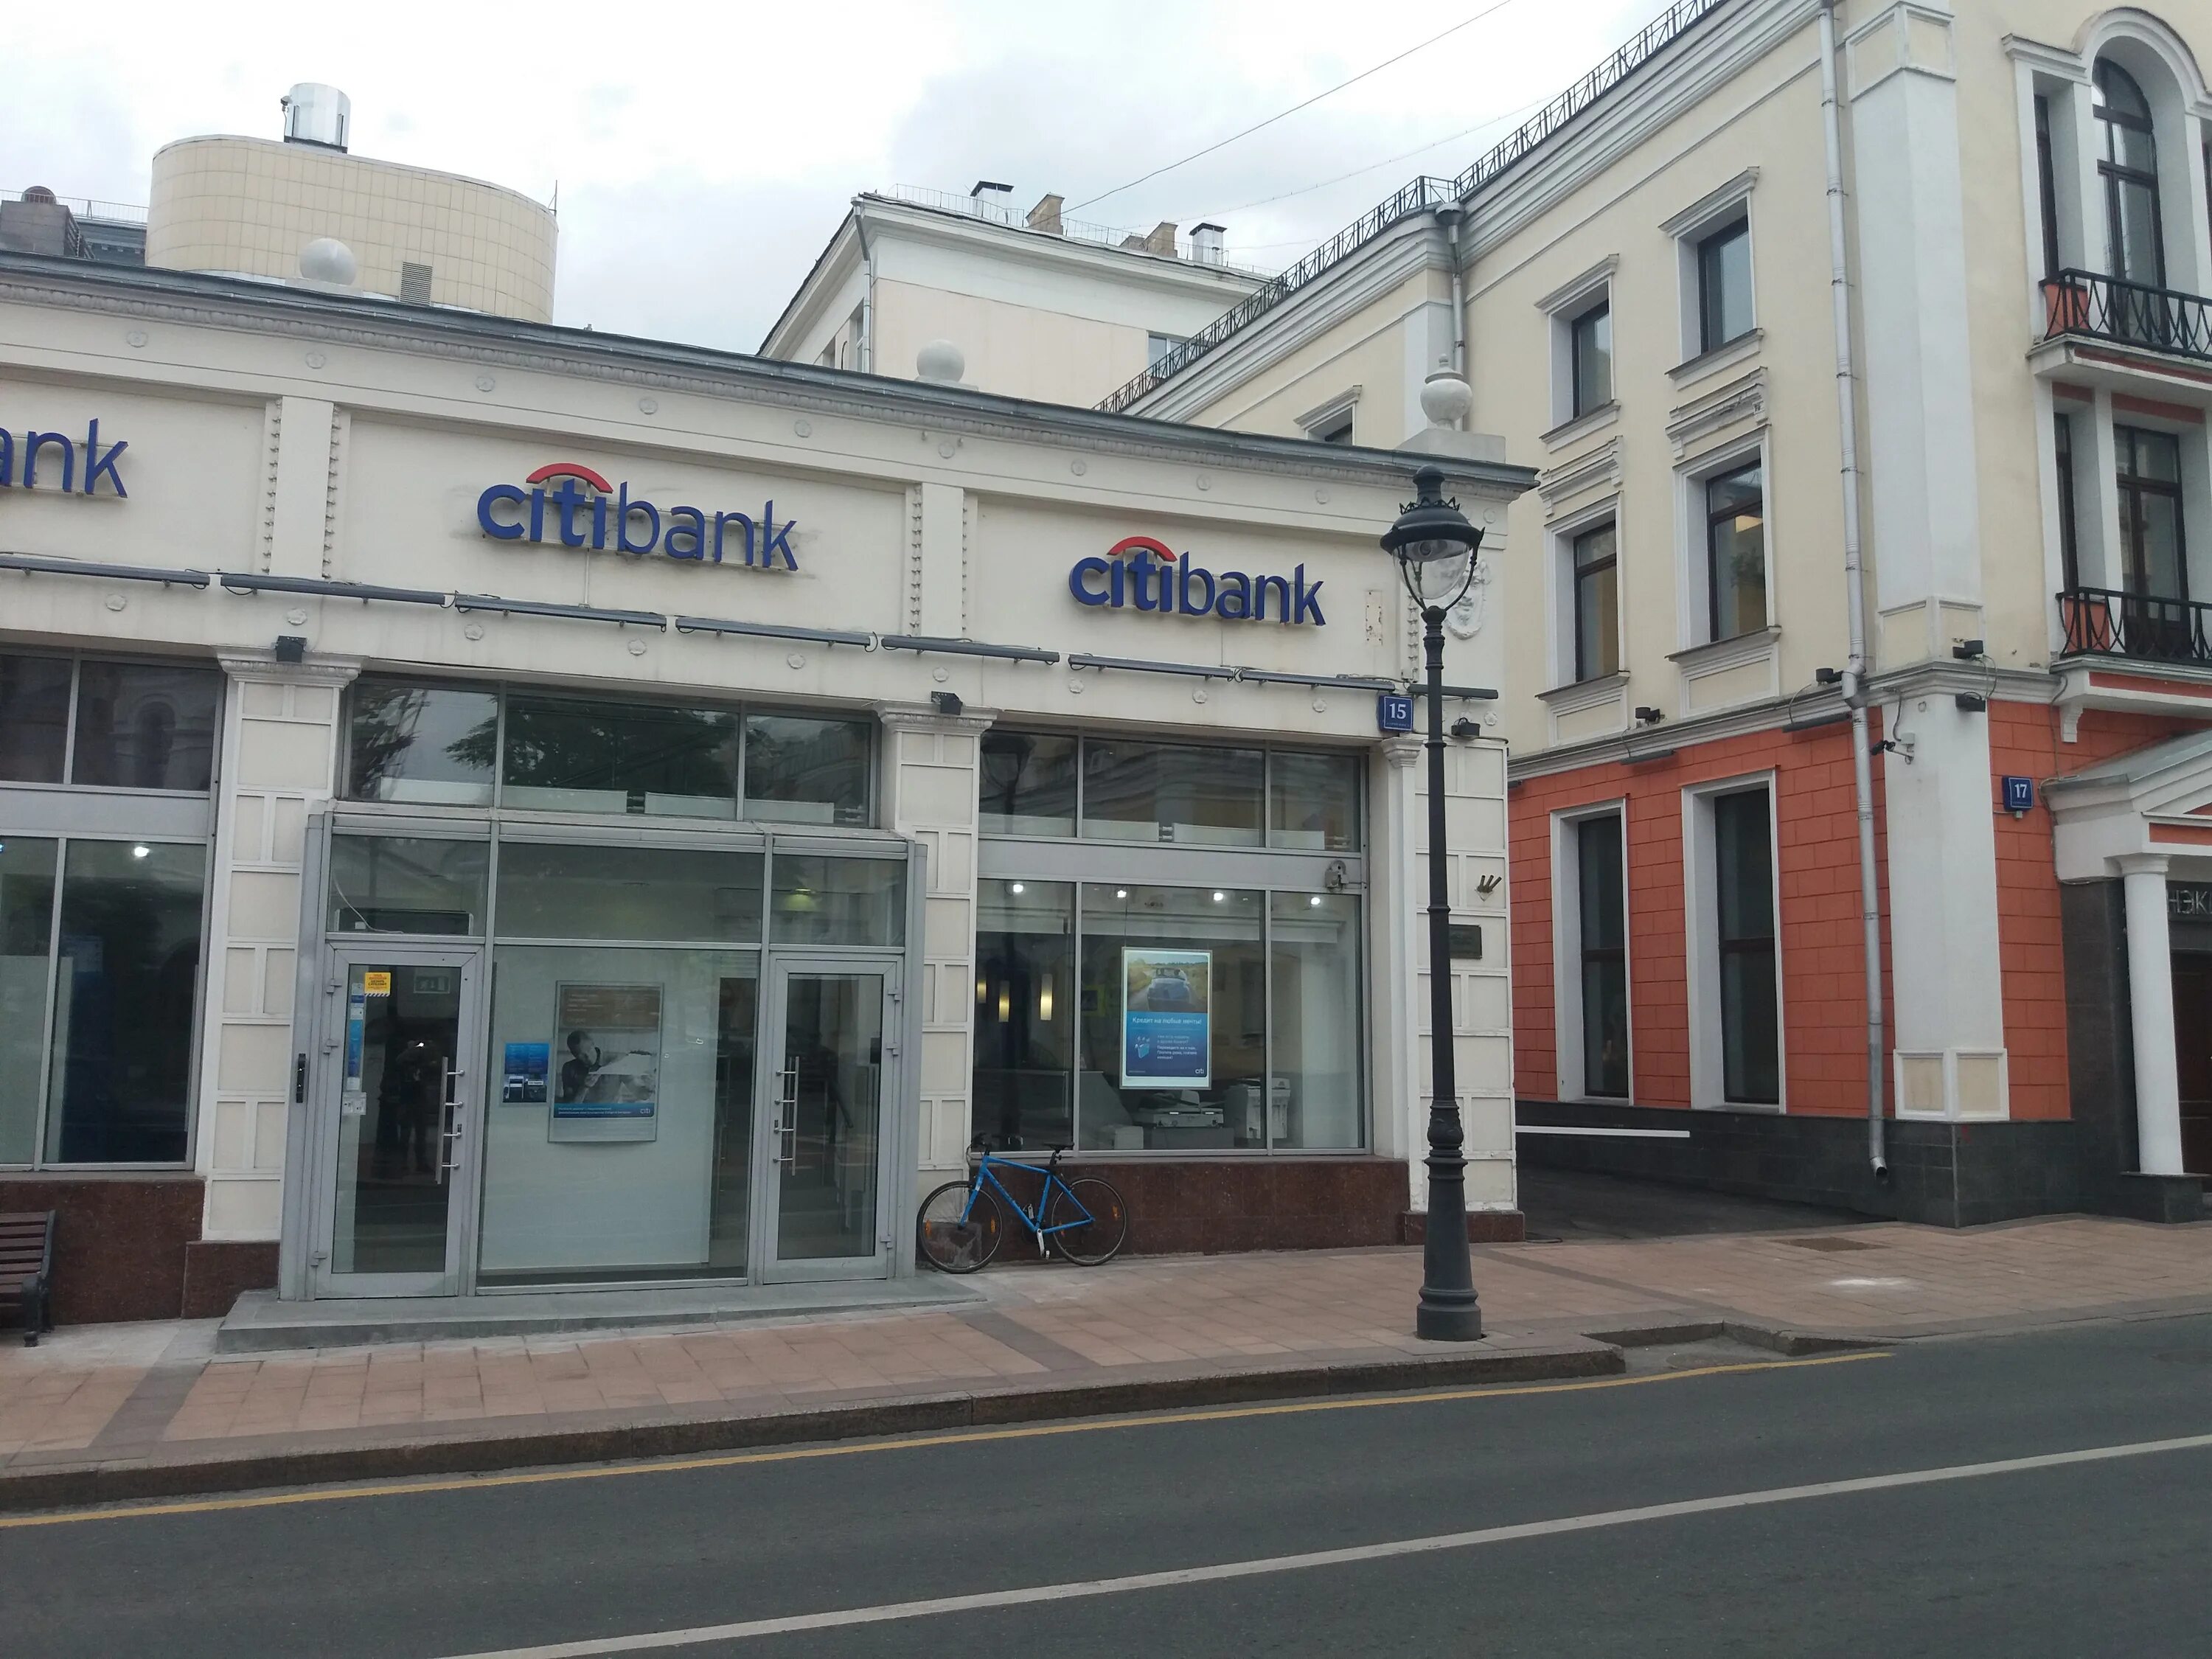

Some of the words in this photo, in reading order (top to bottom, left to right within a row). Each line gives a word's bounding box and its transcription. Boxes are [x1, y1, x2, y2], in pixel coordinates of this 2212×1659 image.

[477, 479, 799, 571] citibank
[1069, 550, 1326, 627] citibank
[1389, 703, 1406, 719] 15
[2014, 783, 2027, 798] 17
